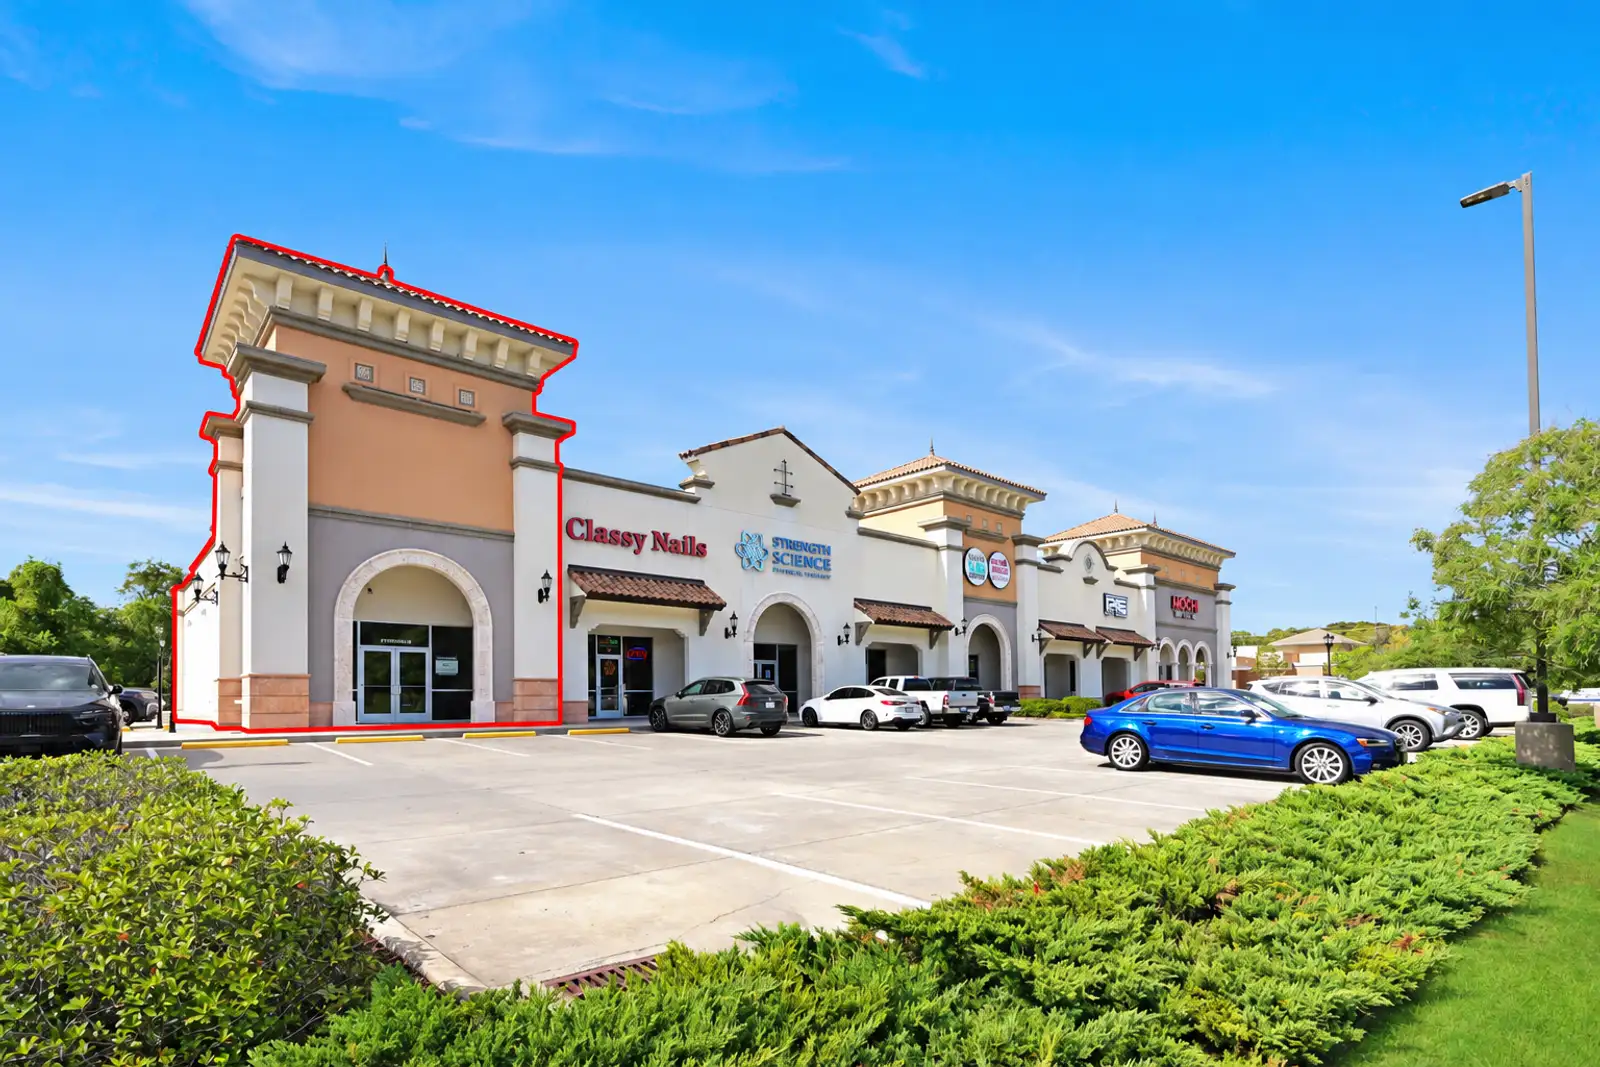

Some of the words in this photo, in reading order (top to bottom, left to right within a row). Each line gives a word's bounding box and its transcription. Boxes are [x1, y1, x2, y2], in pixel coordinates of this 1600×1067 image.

[565, 517, 648, 555] Classy
[651, 530, 708, 558] Nails
[772, 536, 832, 556] STRENGTH
[772, 551, 832, 571] SCIENCE
